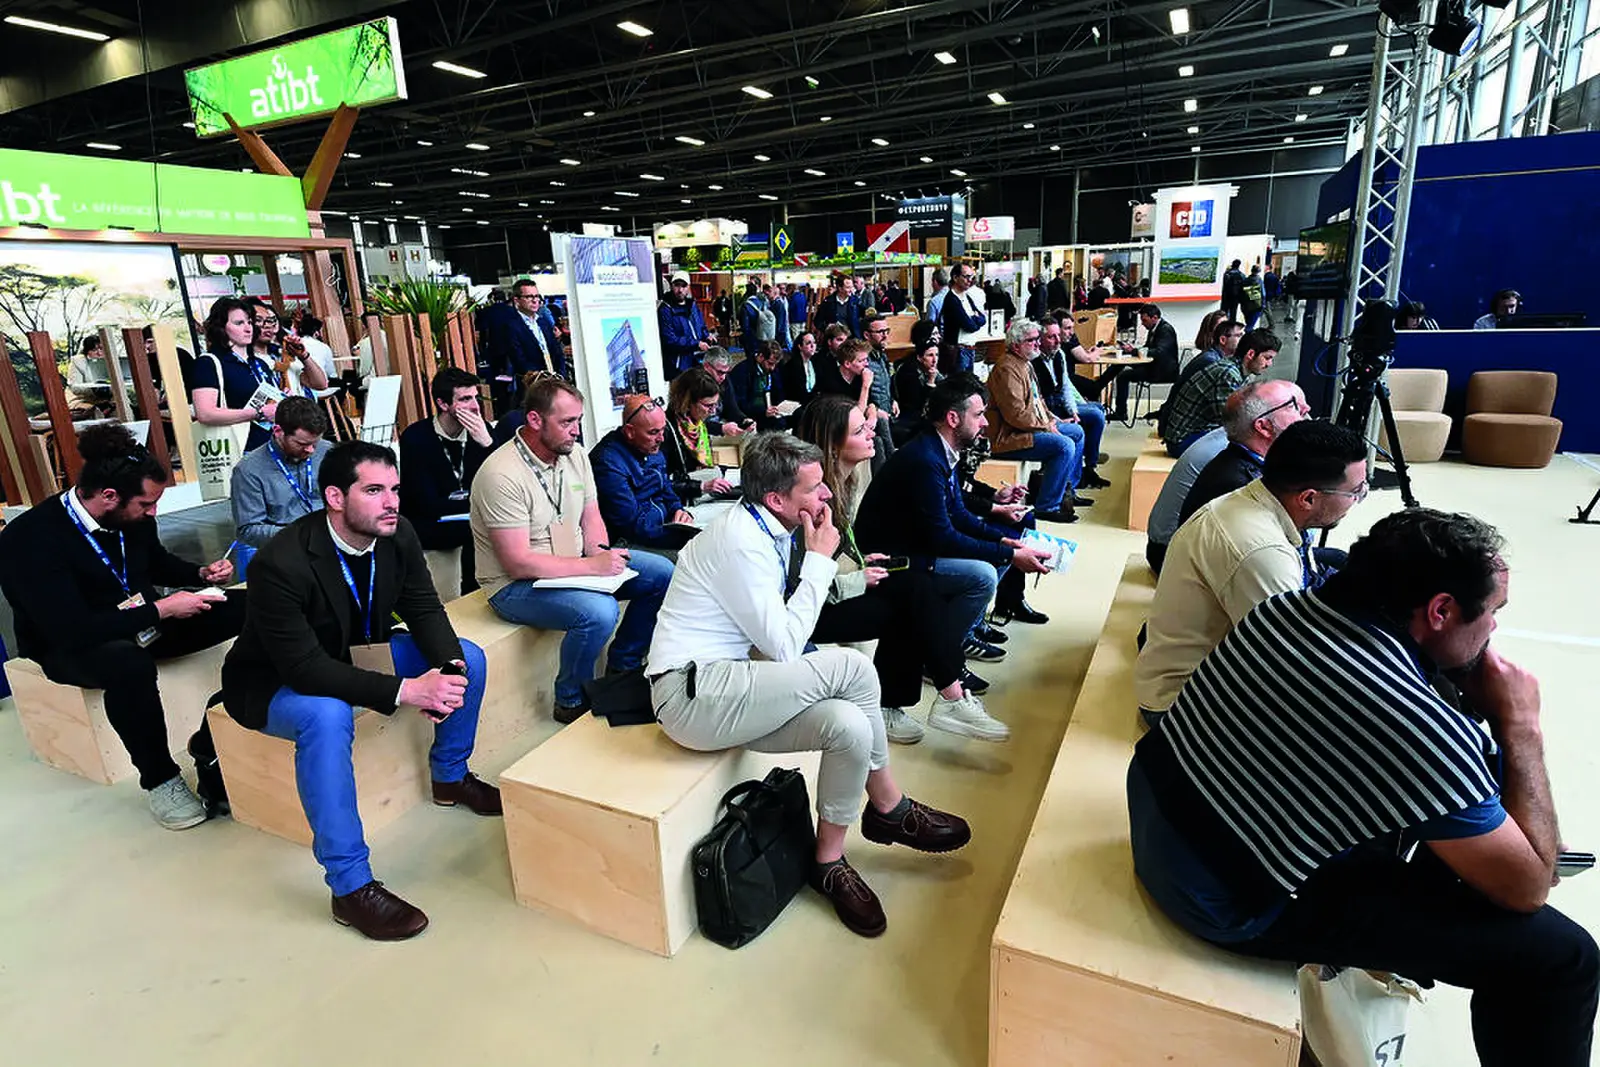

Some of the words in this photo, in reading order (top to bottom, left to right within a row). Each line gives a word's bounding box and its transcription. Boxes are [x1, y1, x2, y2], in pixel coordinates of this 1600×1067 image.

[250, 65, 323, 117] atibt
[0, 180, 66, 222] bt
[1176, 210, 1207, 226] CID
[199, 438, 230, 457] OUI
